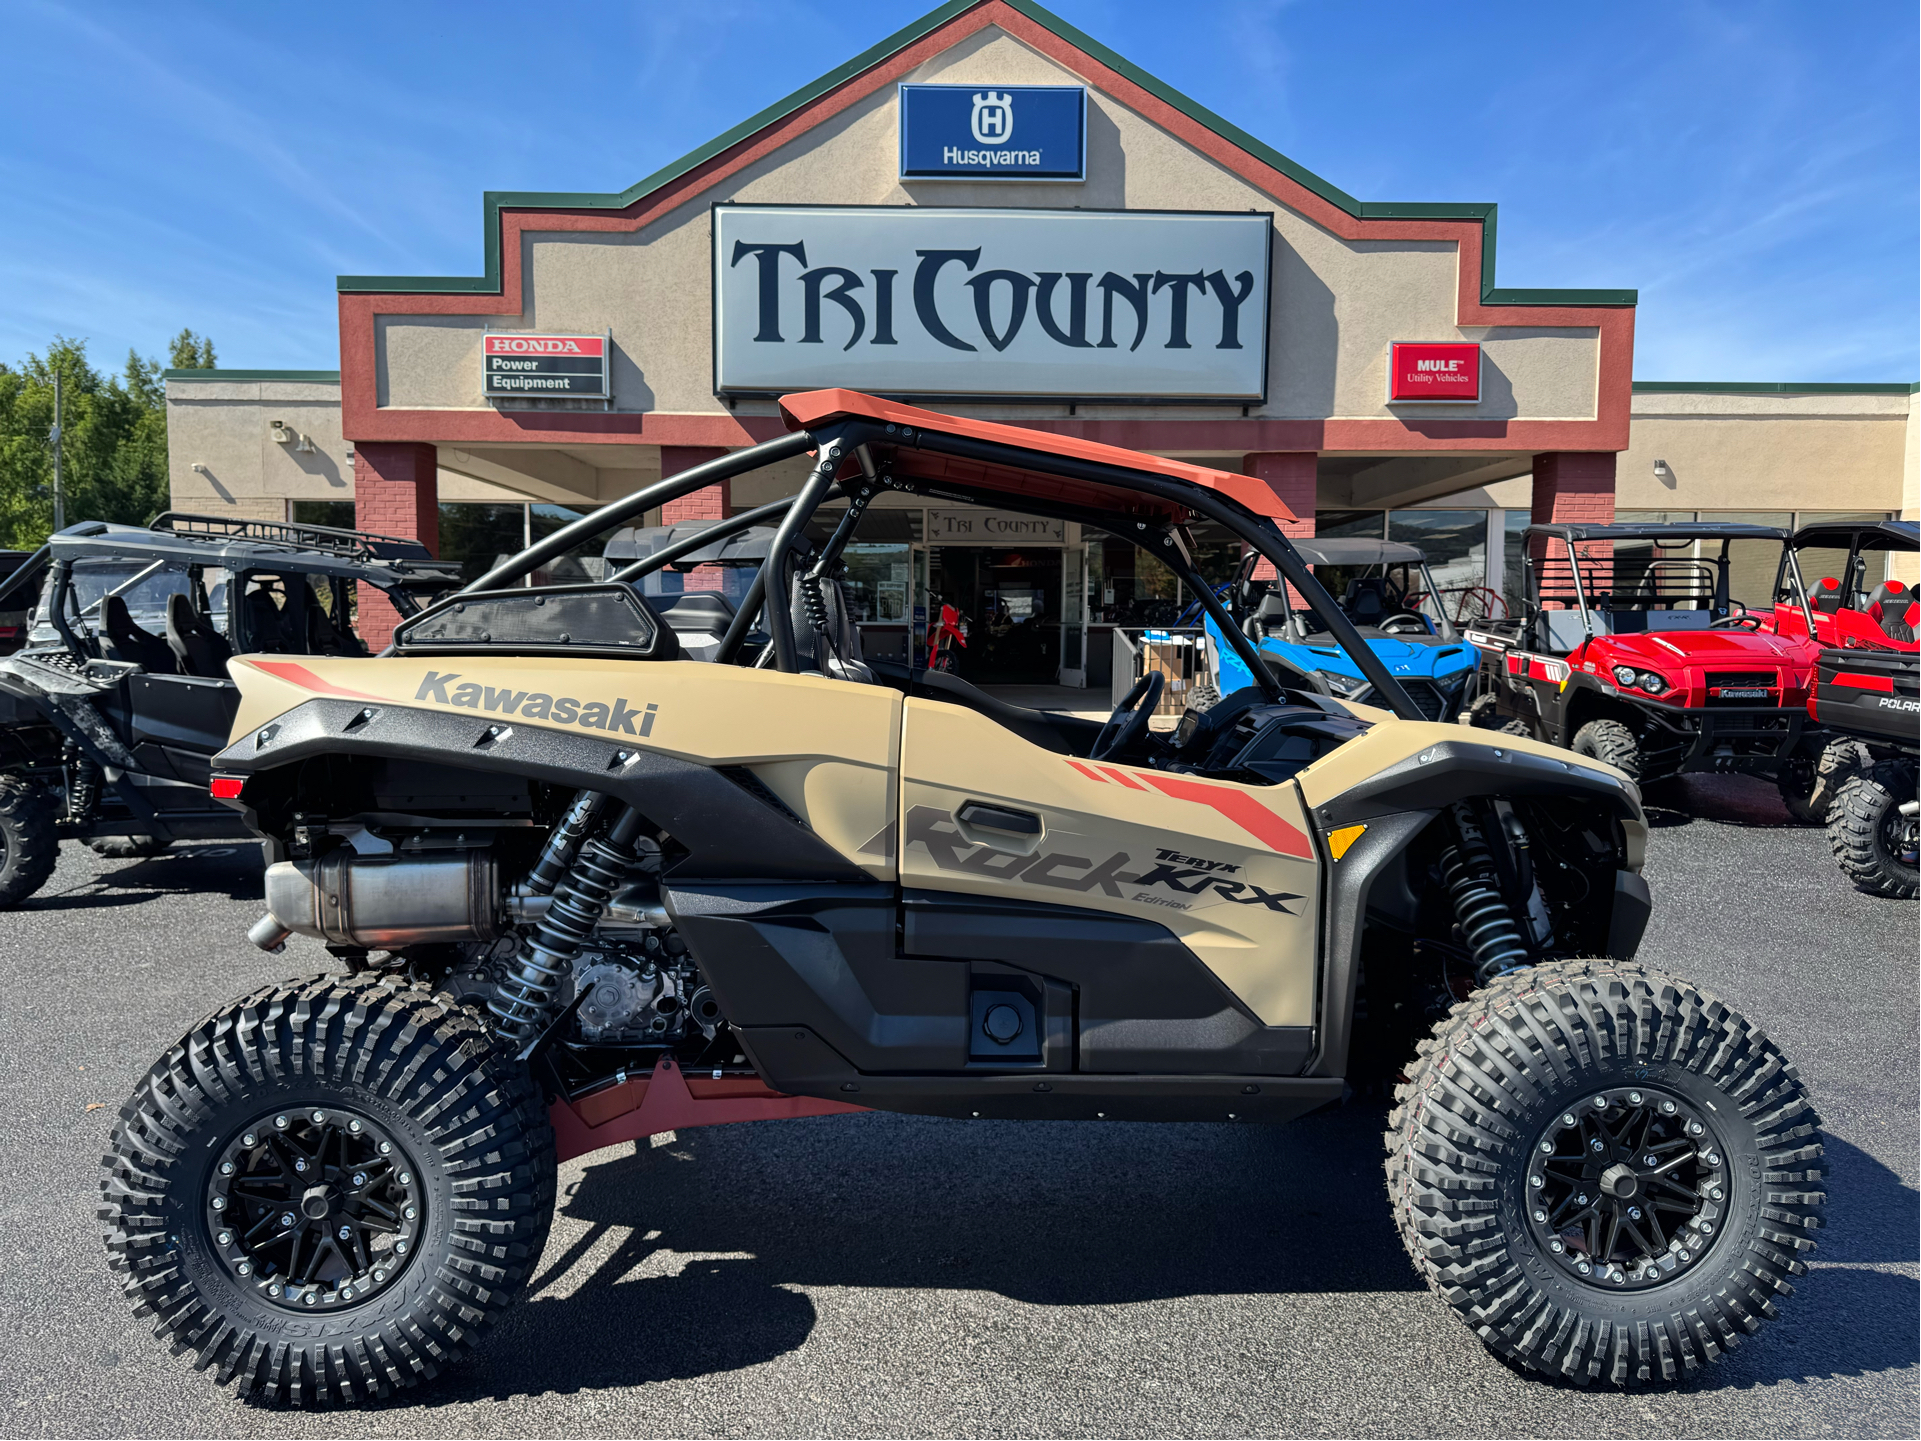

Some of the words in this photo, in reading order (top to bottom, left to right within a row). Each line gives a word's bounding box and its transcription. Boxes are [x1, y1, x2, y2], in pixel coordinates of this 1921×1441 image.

[943, 146, 1041, 168] Husqvarna
[731, 239, 898, 351] TRI
[915, 246, 1253, 352] COUNTY
[491, 339, 582, 352] HONDA
[491, 358, 539, 371] Power
[491, 375, 571, 390] Equipment
[1407, 373, 1434, 384] Utility
[1435, 373, 1469, 383] Vehicles
[943, 516, 973, 534] TRI
[984, 517, 1049, 534] COUNTY
[1721, 689, 1768, 698] Kawasaki
[414, 670, 659, 738] Kawasaki
[1133, 862, 1309, 916] KRX
